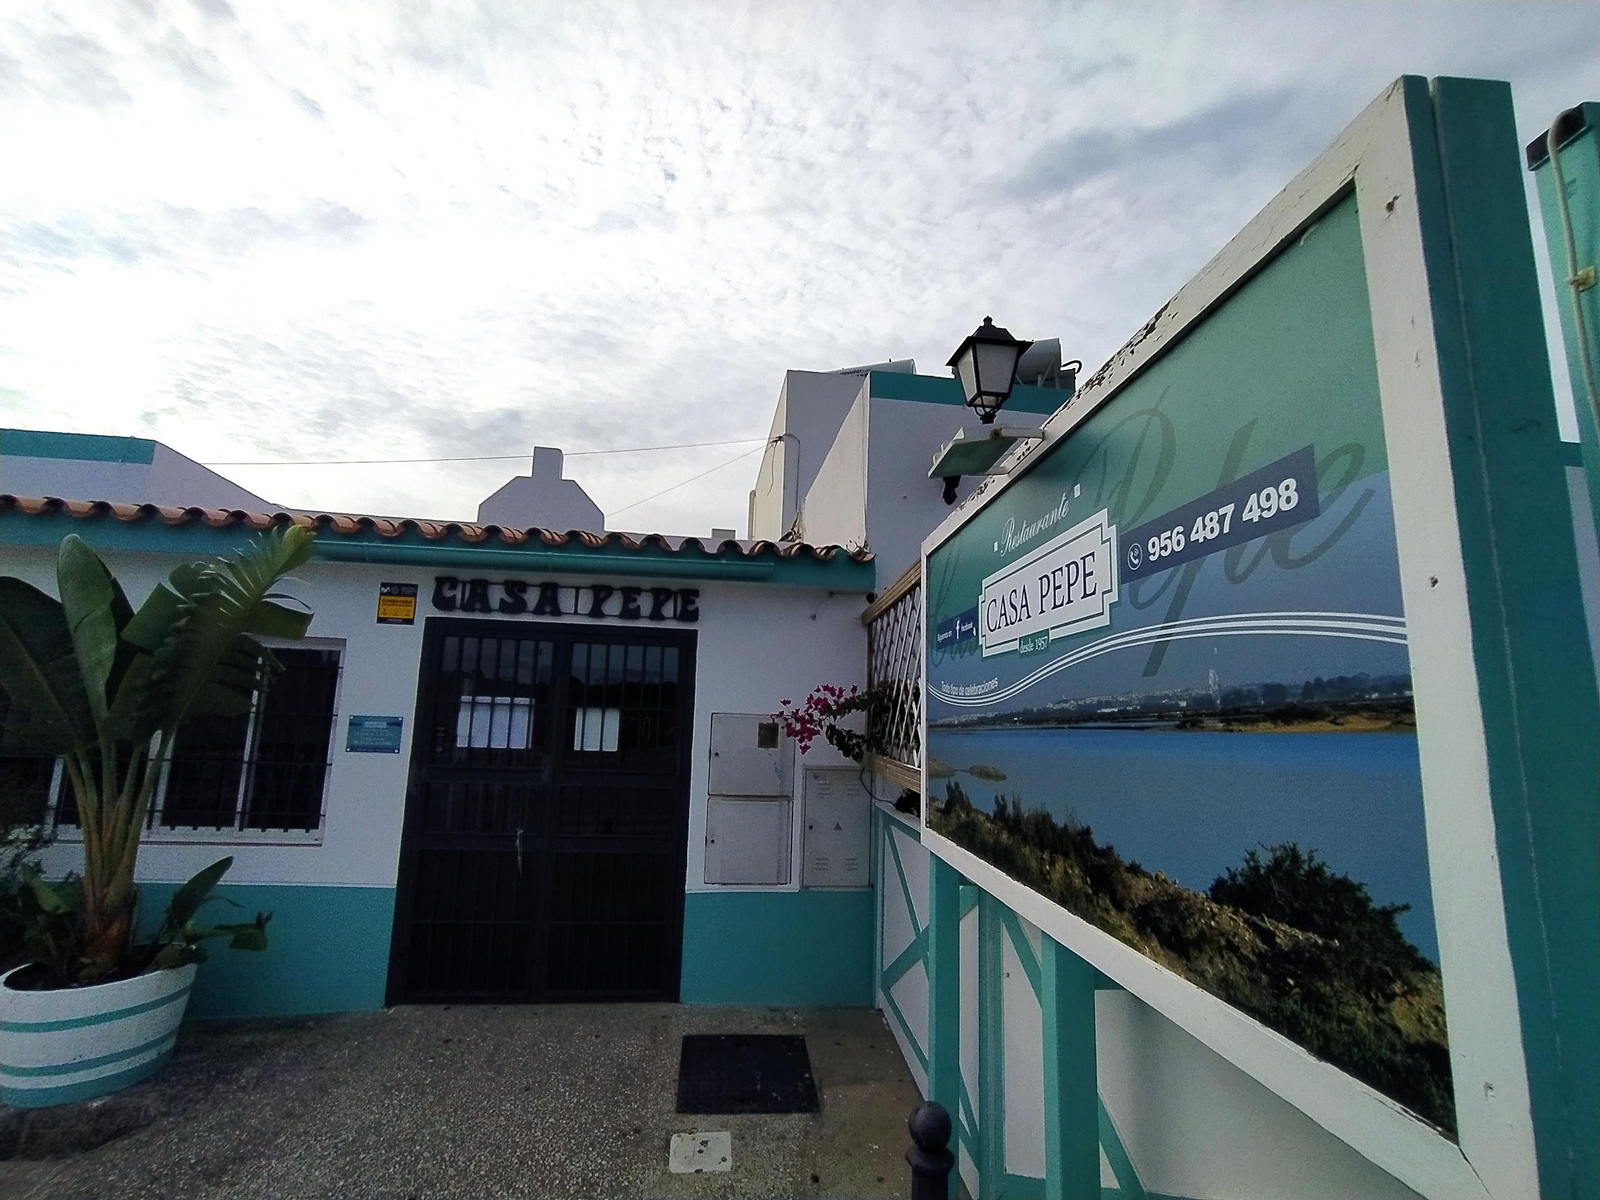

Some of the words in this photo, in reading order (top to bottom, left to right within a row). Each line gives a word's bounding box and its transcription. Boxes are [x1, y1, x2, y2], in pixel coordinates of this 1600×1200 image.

[1000, 492, 1070, 557] Restaurante
[1147, 525, 1186, 562] 956
[1190, 503, 1235, 543] 487
[1242, 478, 1299, 523] 498
[432, 576, 561, 616] CASA
[589, 584, 700, 622] PEPE
[986, 583, 1032, 633] CASA
[1038, 551, 1098, 615] PEPE
[1019, 638, 1034, 654] desde
[1035, 635, 1049, 651] 1957
[941, 680, 951, 694] Todo
[958, 684, 965, 696] de
[964, 677, 999, 696] celebraciones
